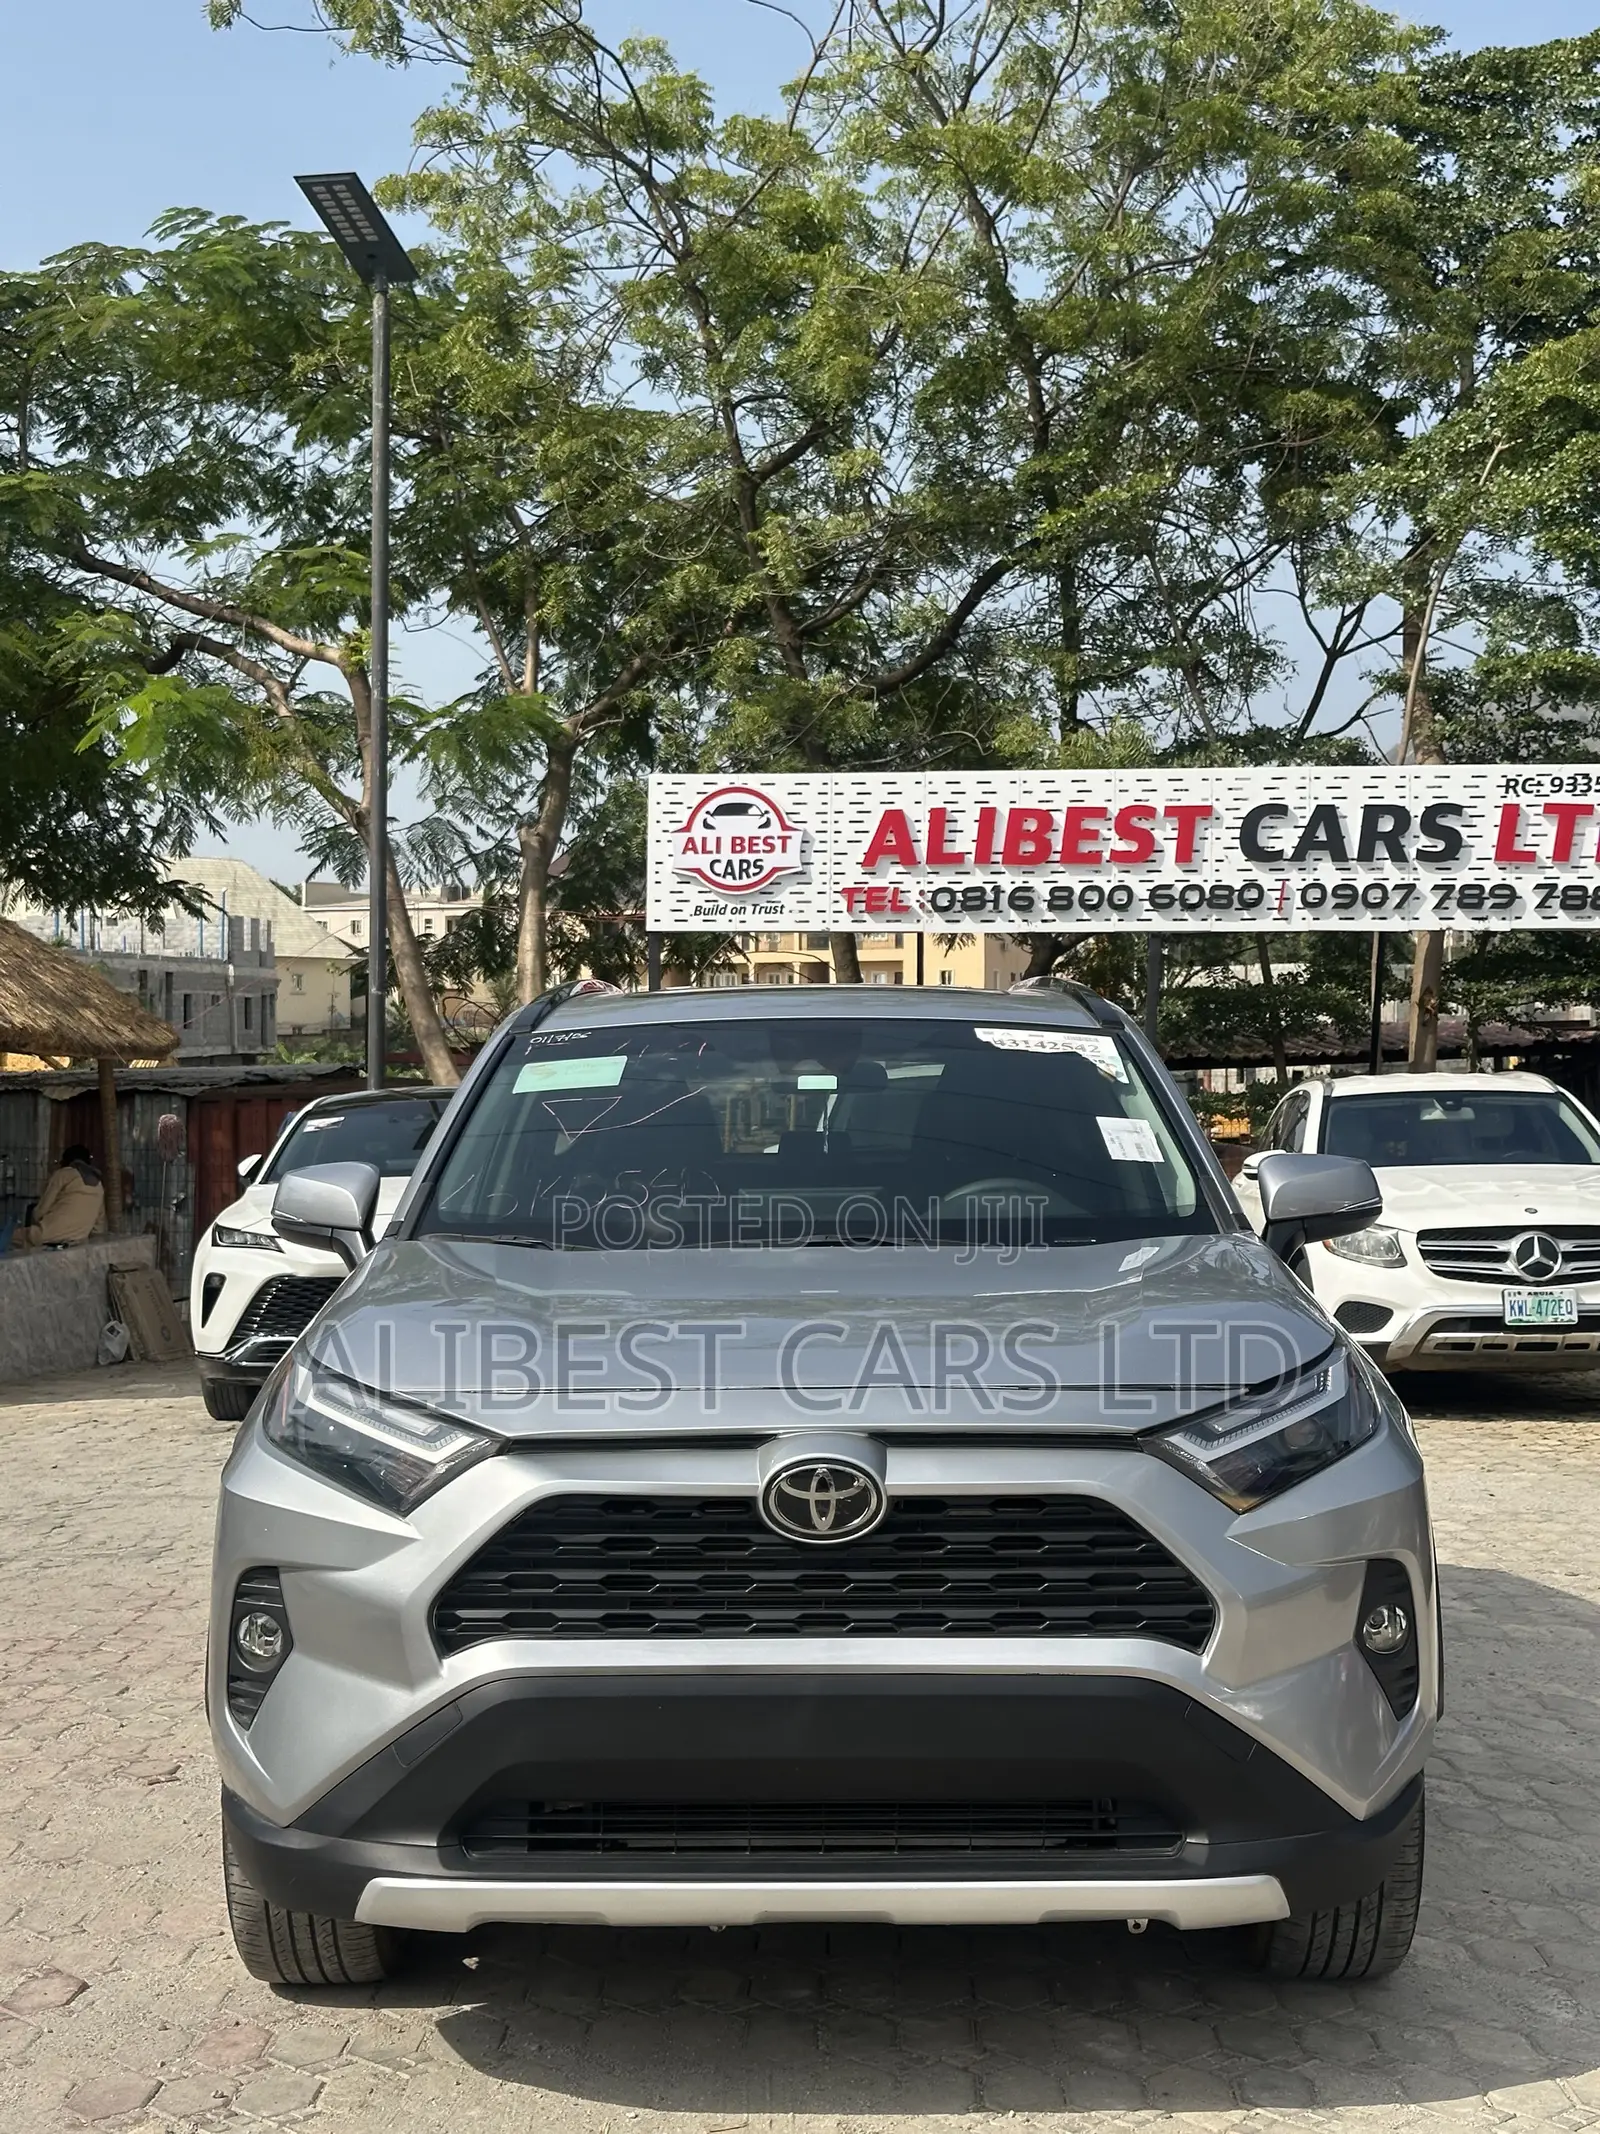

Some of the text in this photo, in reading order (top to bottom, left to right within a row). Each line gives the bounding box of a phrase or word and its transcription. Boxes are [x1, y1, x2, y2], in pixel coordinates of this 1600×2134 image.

[681, 836, 792, 855] ALI BEST
[861, 803, 1600, 868] ALIBEST CARS LT
[709, 858, 764, 881] CARS
[931, 884, 1035, 913] 0816
[1048, 884, 1134, 912] 800
[1149, 883, 1265, 911] 6080
[1300, 883, 1417, 910] 0907
[1431, 883, 1517, 910] 789
[694, 903, 785, 917] Build on Trust
